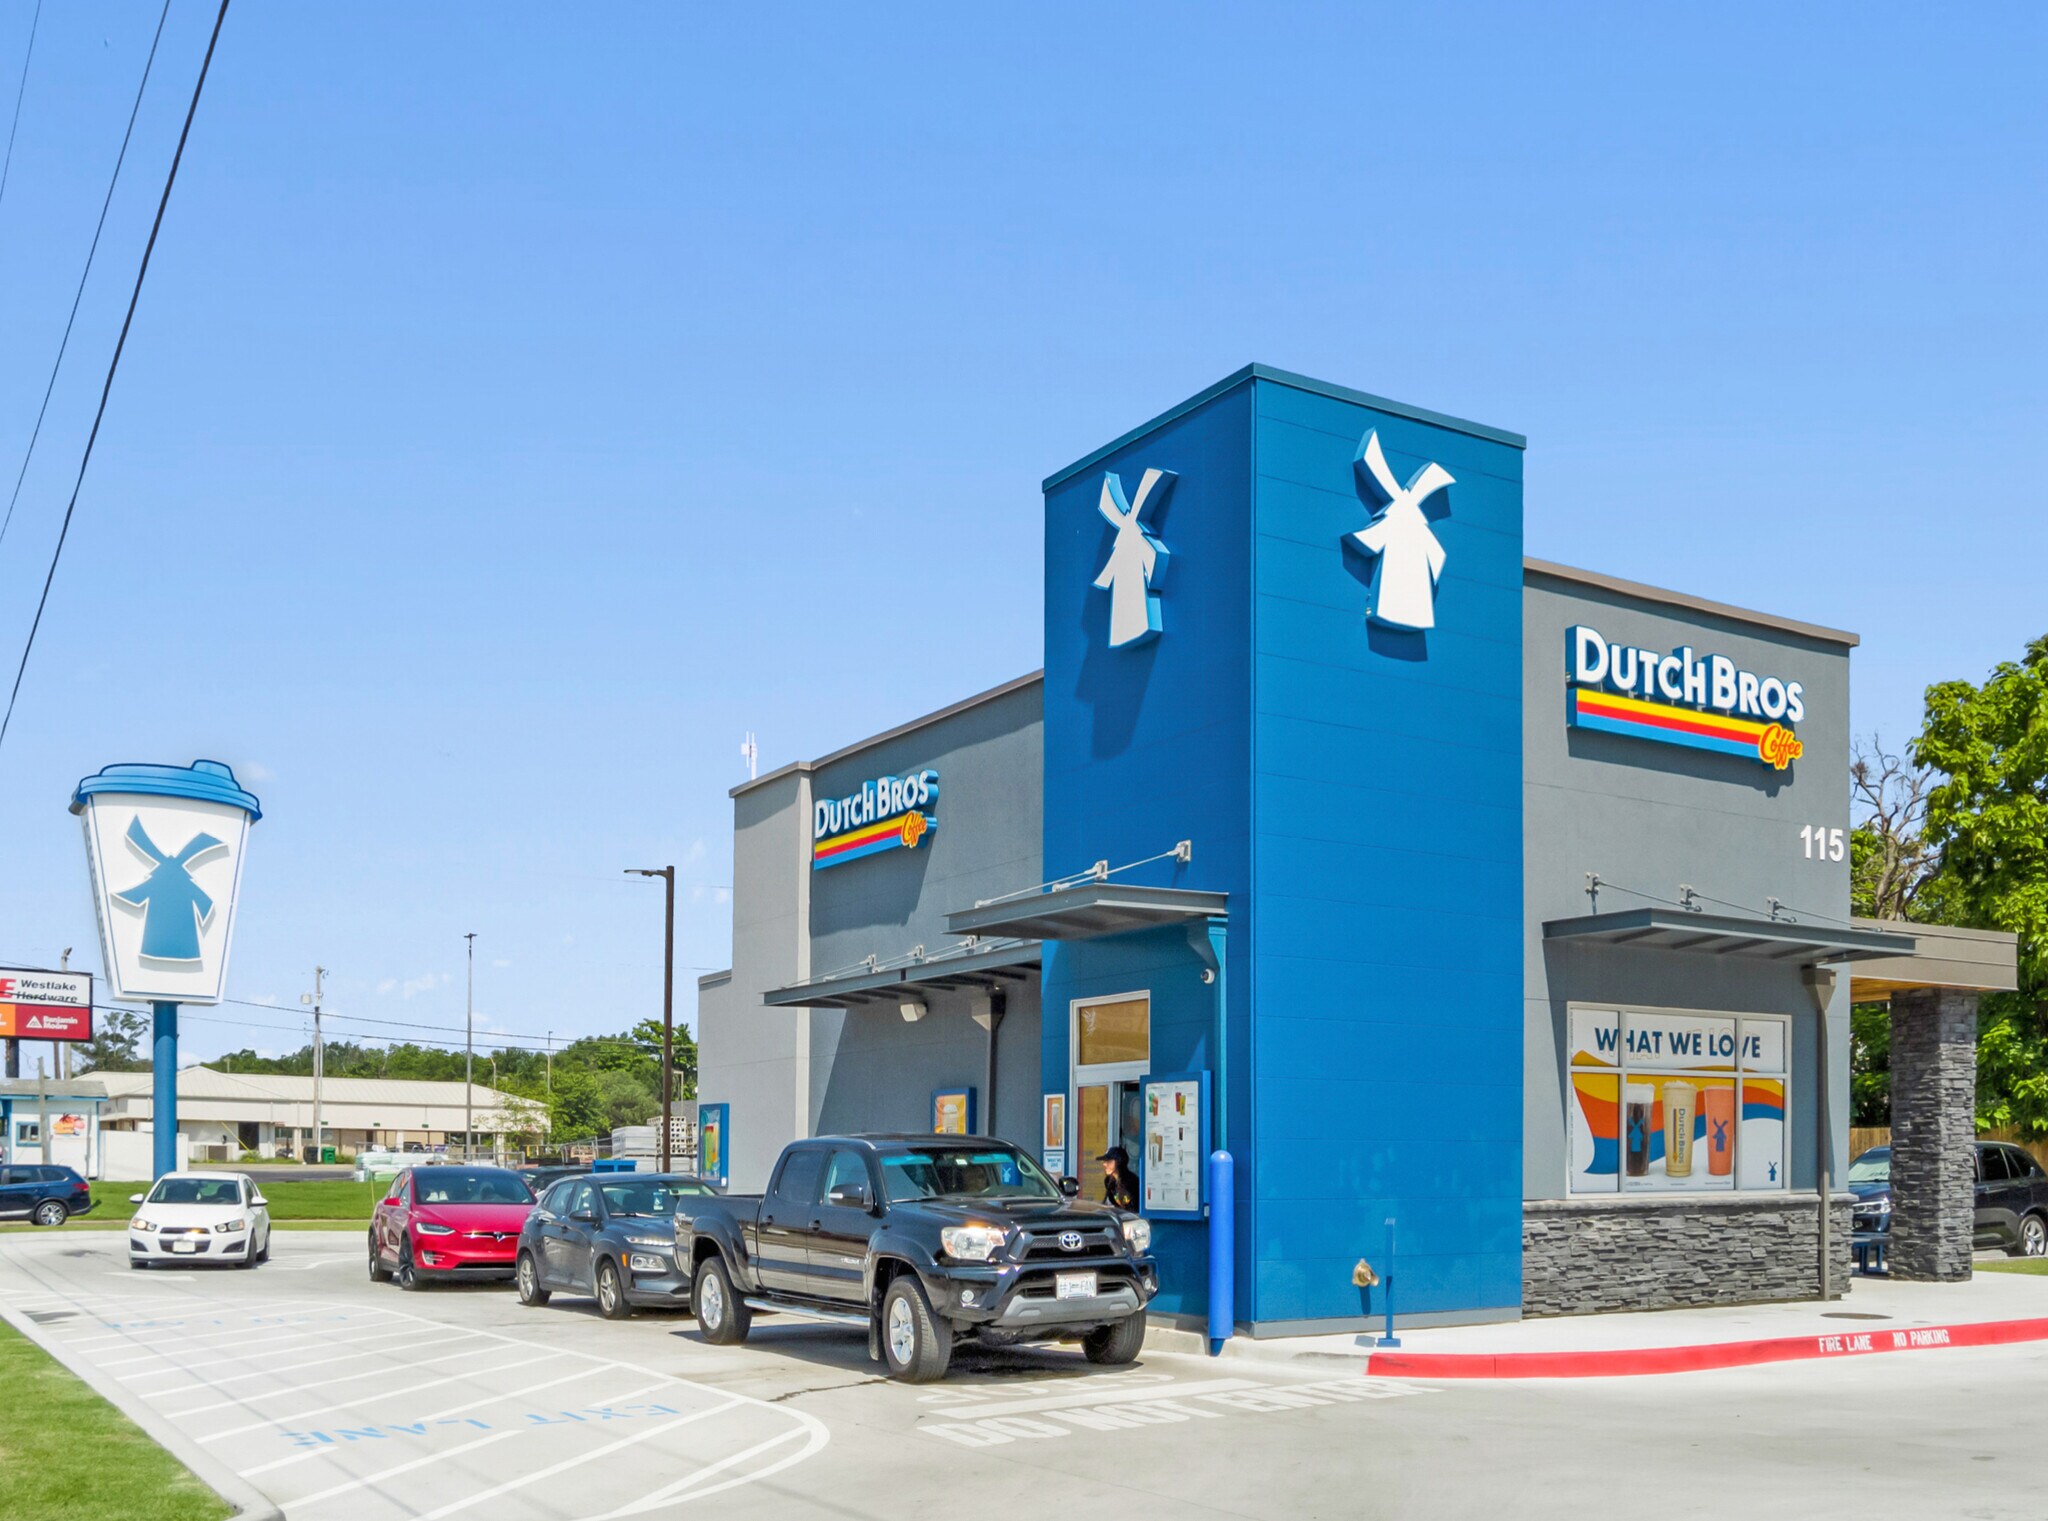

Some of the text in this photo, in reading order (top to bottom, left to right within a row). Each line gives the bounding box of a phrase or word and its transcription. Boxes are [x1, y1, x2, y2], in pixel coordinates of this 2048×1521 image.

[1576, 626, 1804, 722] DUTCH BROS
[1760, 723, 1802, 769] Coffee
[815, 770, 930, 838] DUTCH BROS
[1800, 825, 1844, 861] 115
[16, 991, 78, 1003] Hardware
[21, 980, 77, 991] Westlake
[1595, 1028, 1662, 1053] WHAT
[1669, 1032, 1701, 1055] WE
[1818, 1329, 1950, 1352] FIRE LANE NO PARKING
[279, 1404, 680, 1446] EXIT LANE
[917, 1379, 1447, 1447] DO NOT ENTER
